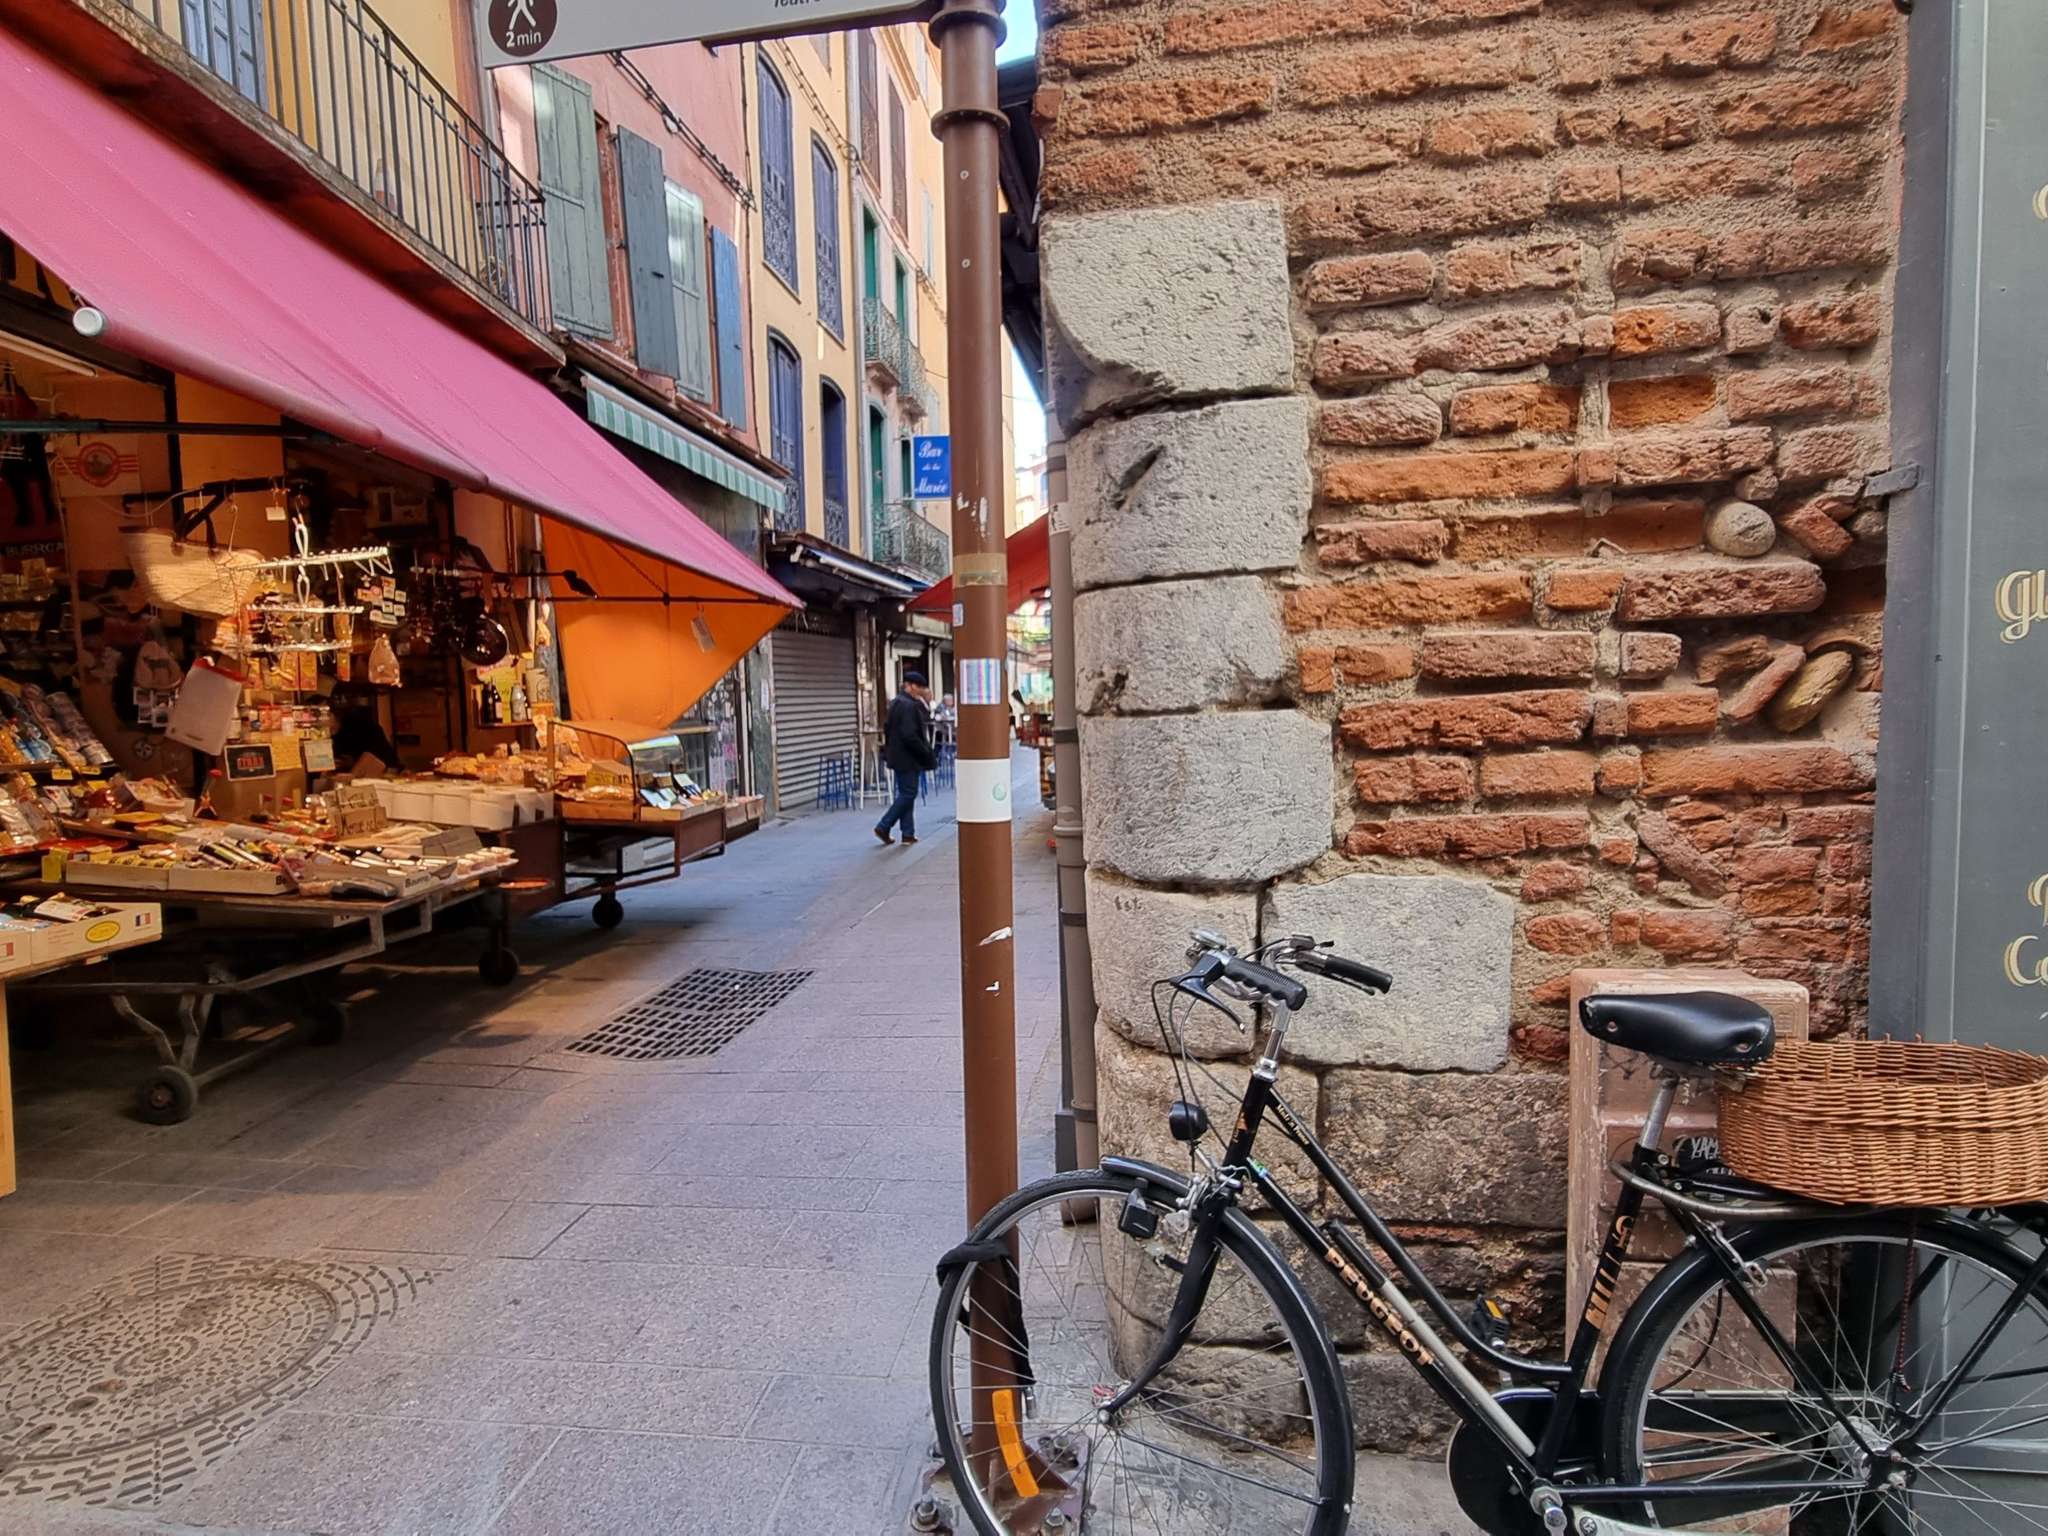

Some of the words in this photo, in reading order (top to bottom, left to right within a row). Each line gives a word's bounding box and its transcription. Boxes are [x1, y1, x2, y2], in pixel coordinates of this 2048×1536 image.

[918, 440, 943, 458] Bar
[915, 477, 948, 494] Marée
[1324, 1247, 1434, 1366] PEUGEOT
